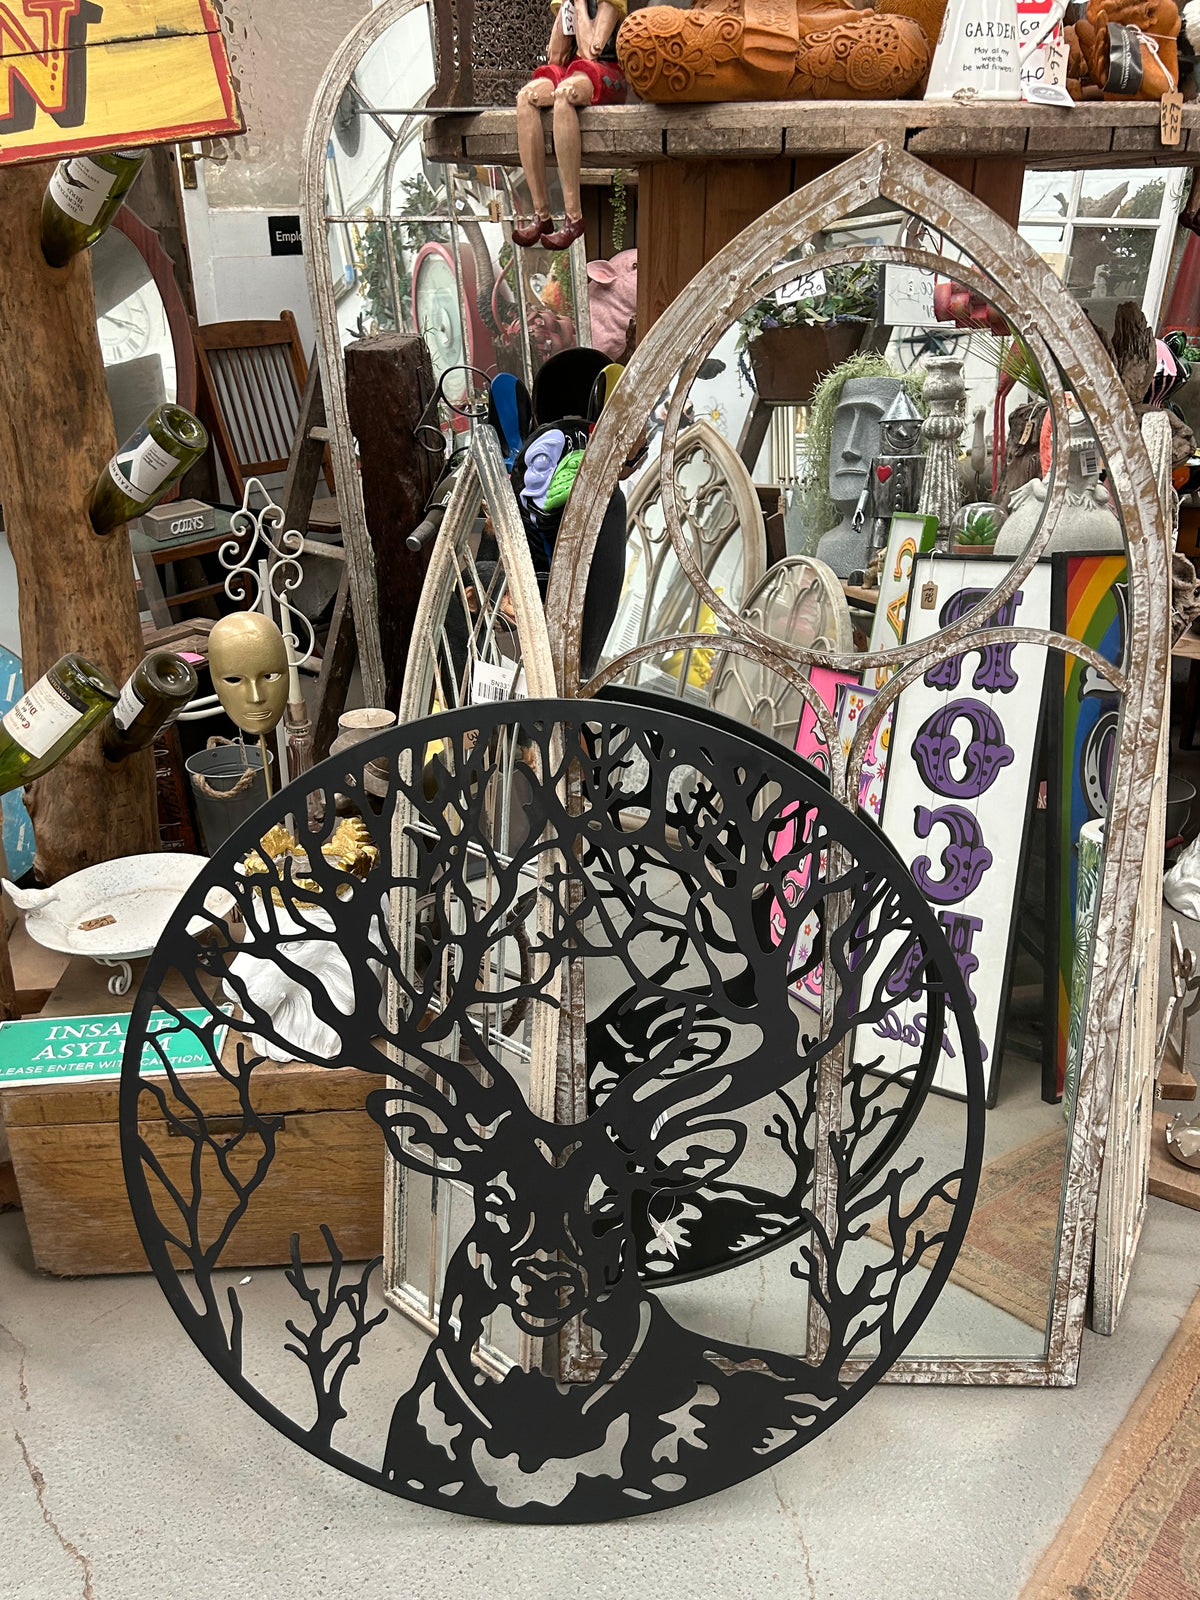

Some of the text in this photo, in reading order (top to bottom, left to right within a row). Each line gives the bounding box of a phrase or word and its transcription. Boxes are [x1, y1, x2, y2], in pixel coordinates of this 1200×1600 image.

[965, 21, 1016, 40] GARDEN
[974, 46, 989, 54] May
[962, 63, 973, 71] be
[976, 62, 989, 70] wild
[1168, 102, 1181, 140] £22
[170, 515, 205, 535] COINS
[0, 1053, 204, 1076] LEASE ENTER WIT CATION
